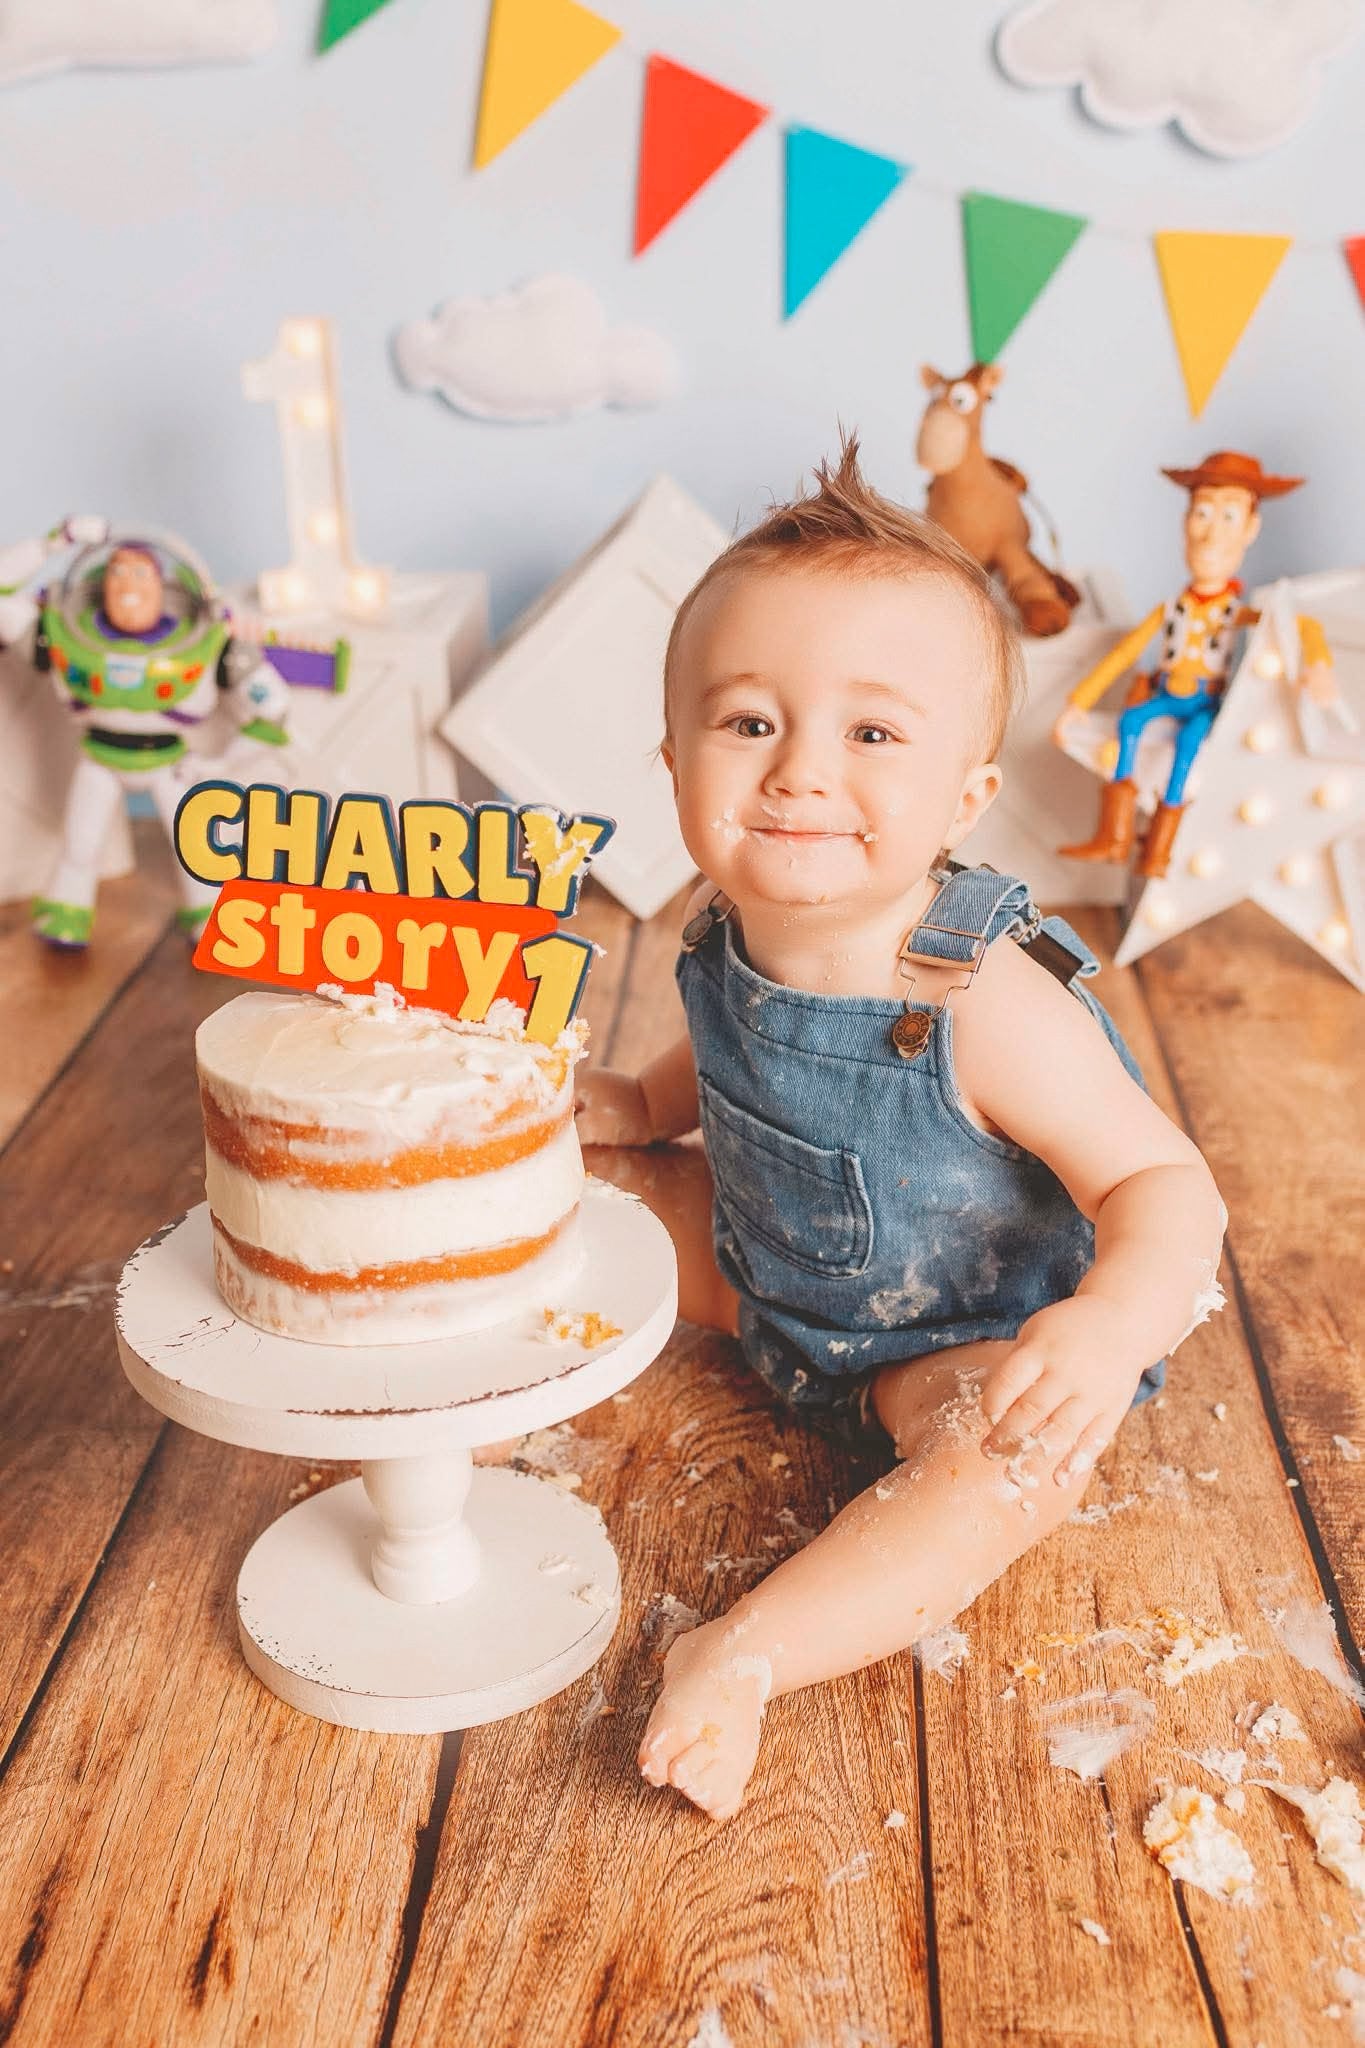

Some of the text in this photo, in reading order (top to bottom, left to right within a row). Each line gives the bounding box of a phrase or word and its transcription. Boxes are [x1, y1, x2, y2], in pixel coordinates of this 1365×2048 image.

[242, 318, 386, 622] 1
[175, 781, 616, 917] CHARLY
[212, 893, 590, 1048] story 1
